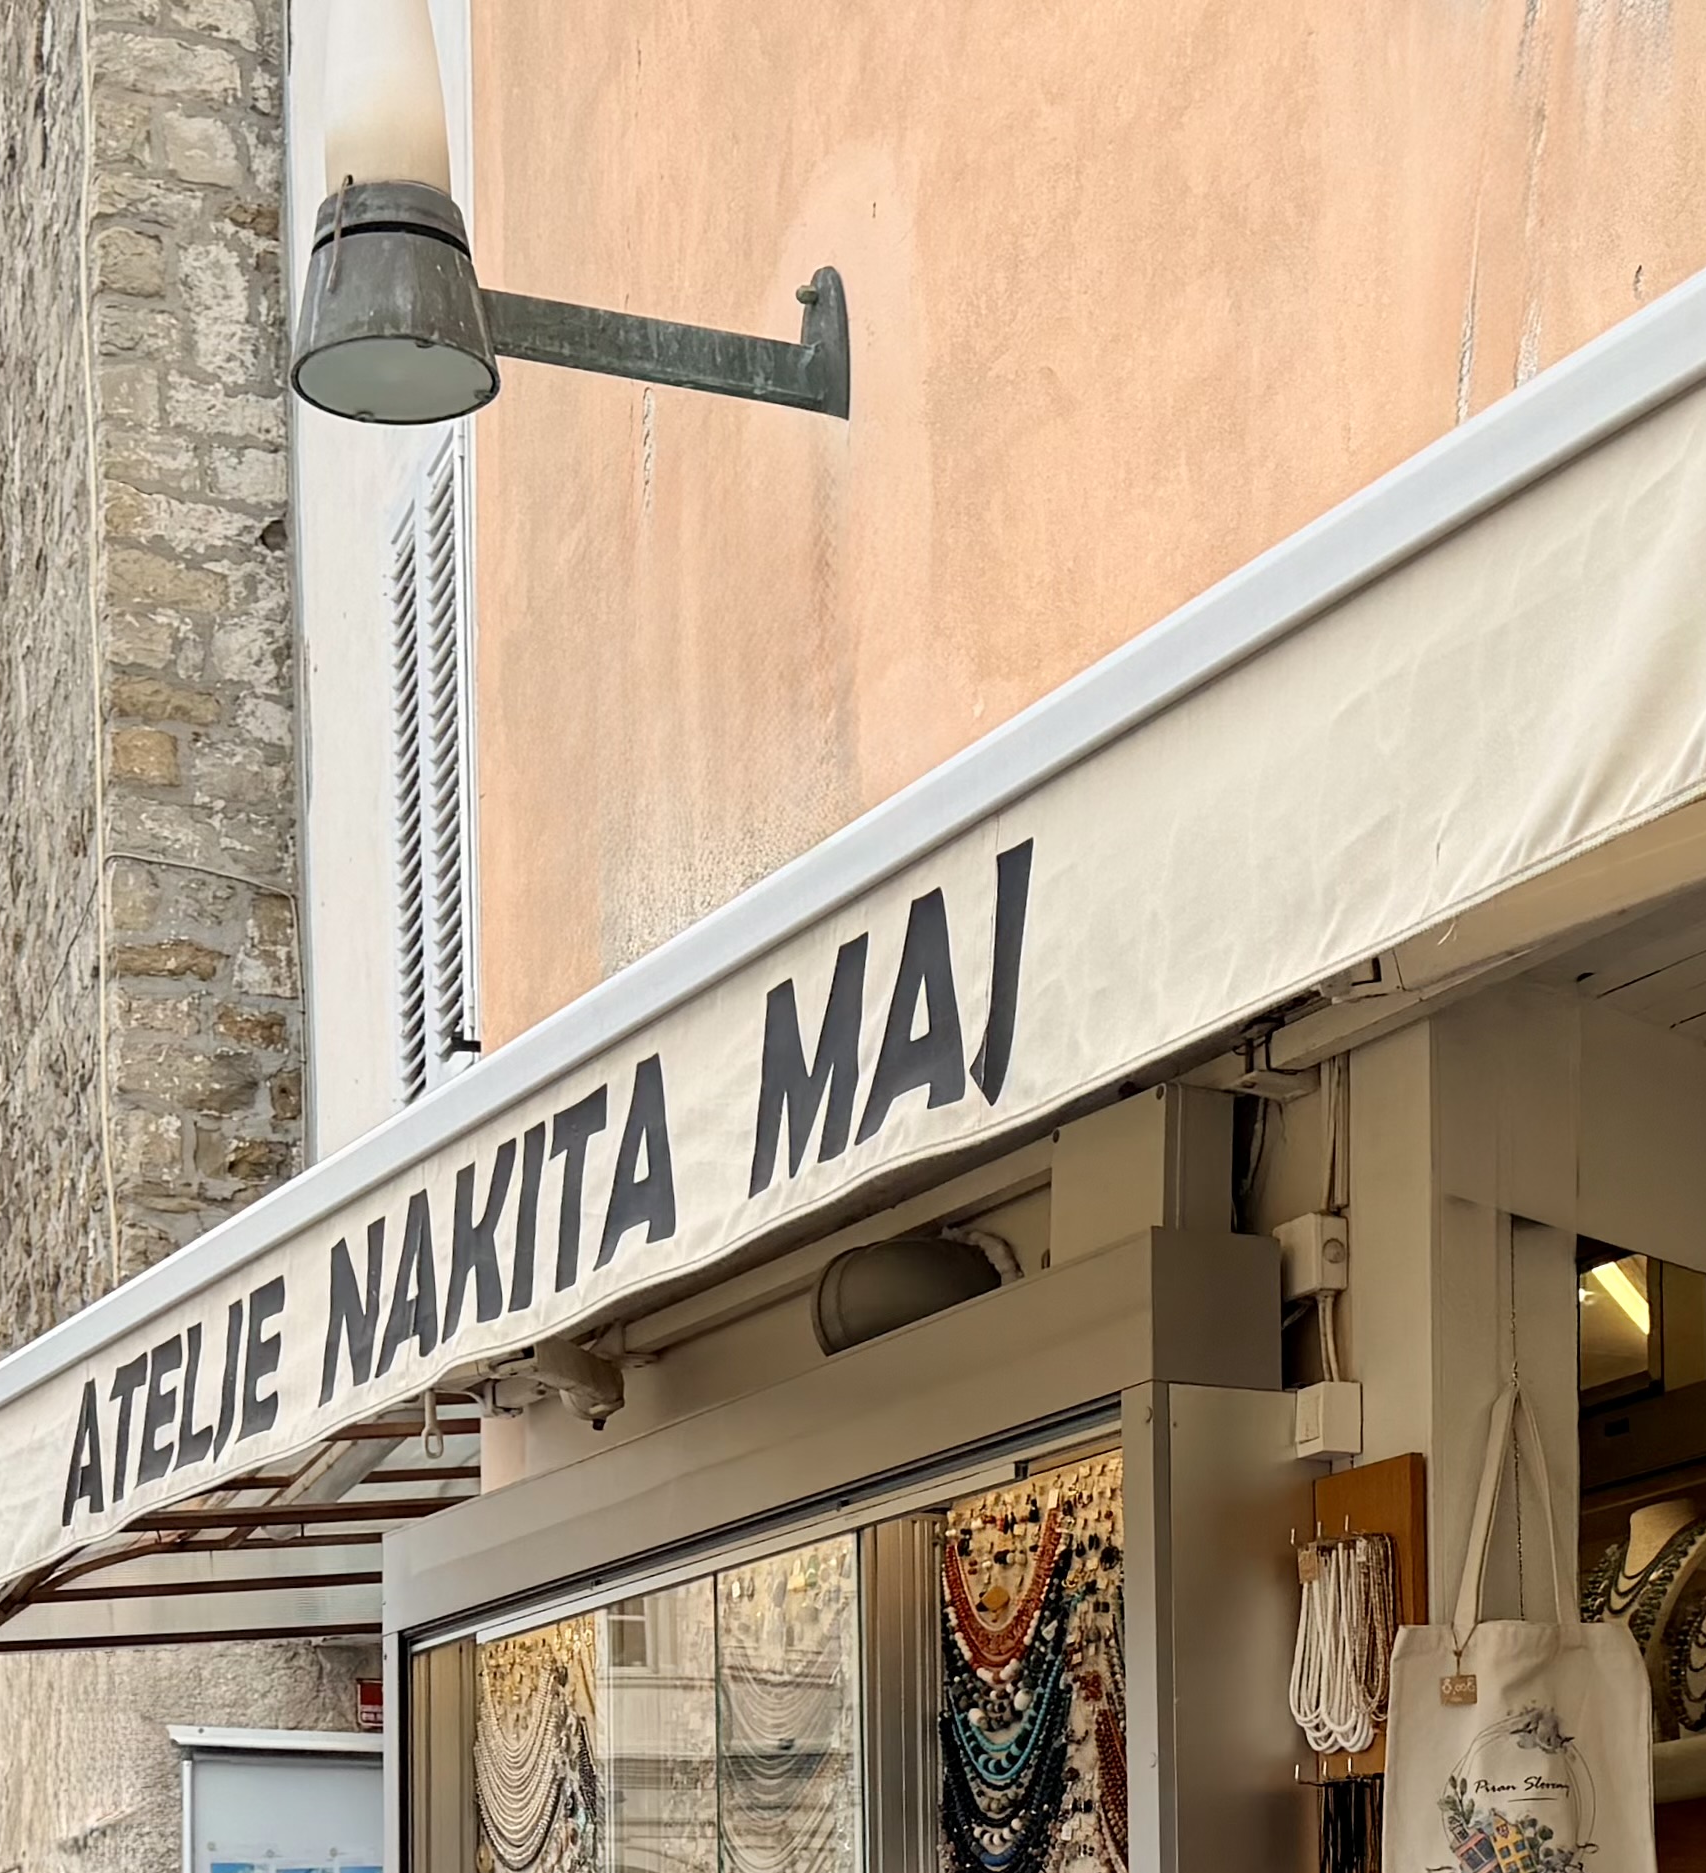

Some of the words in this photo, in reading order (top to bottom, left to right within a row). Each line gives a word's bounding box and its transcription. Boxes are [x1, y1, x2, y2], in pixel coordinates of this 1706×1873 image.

[62, 1274, 286, 1527] ATELJE
[319, 1053, 677, 1406] NAKITA
[748, 838, 1035, 1199] MAJ
